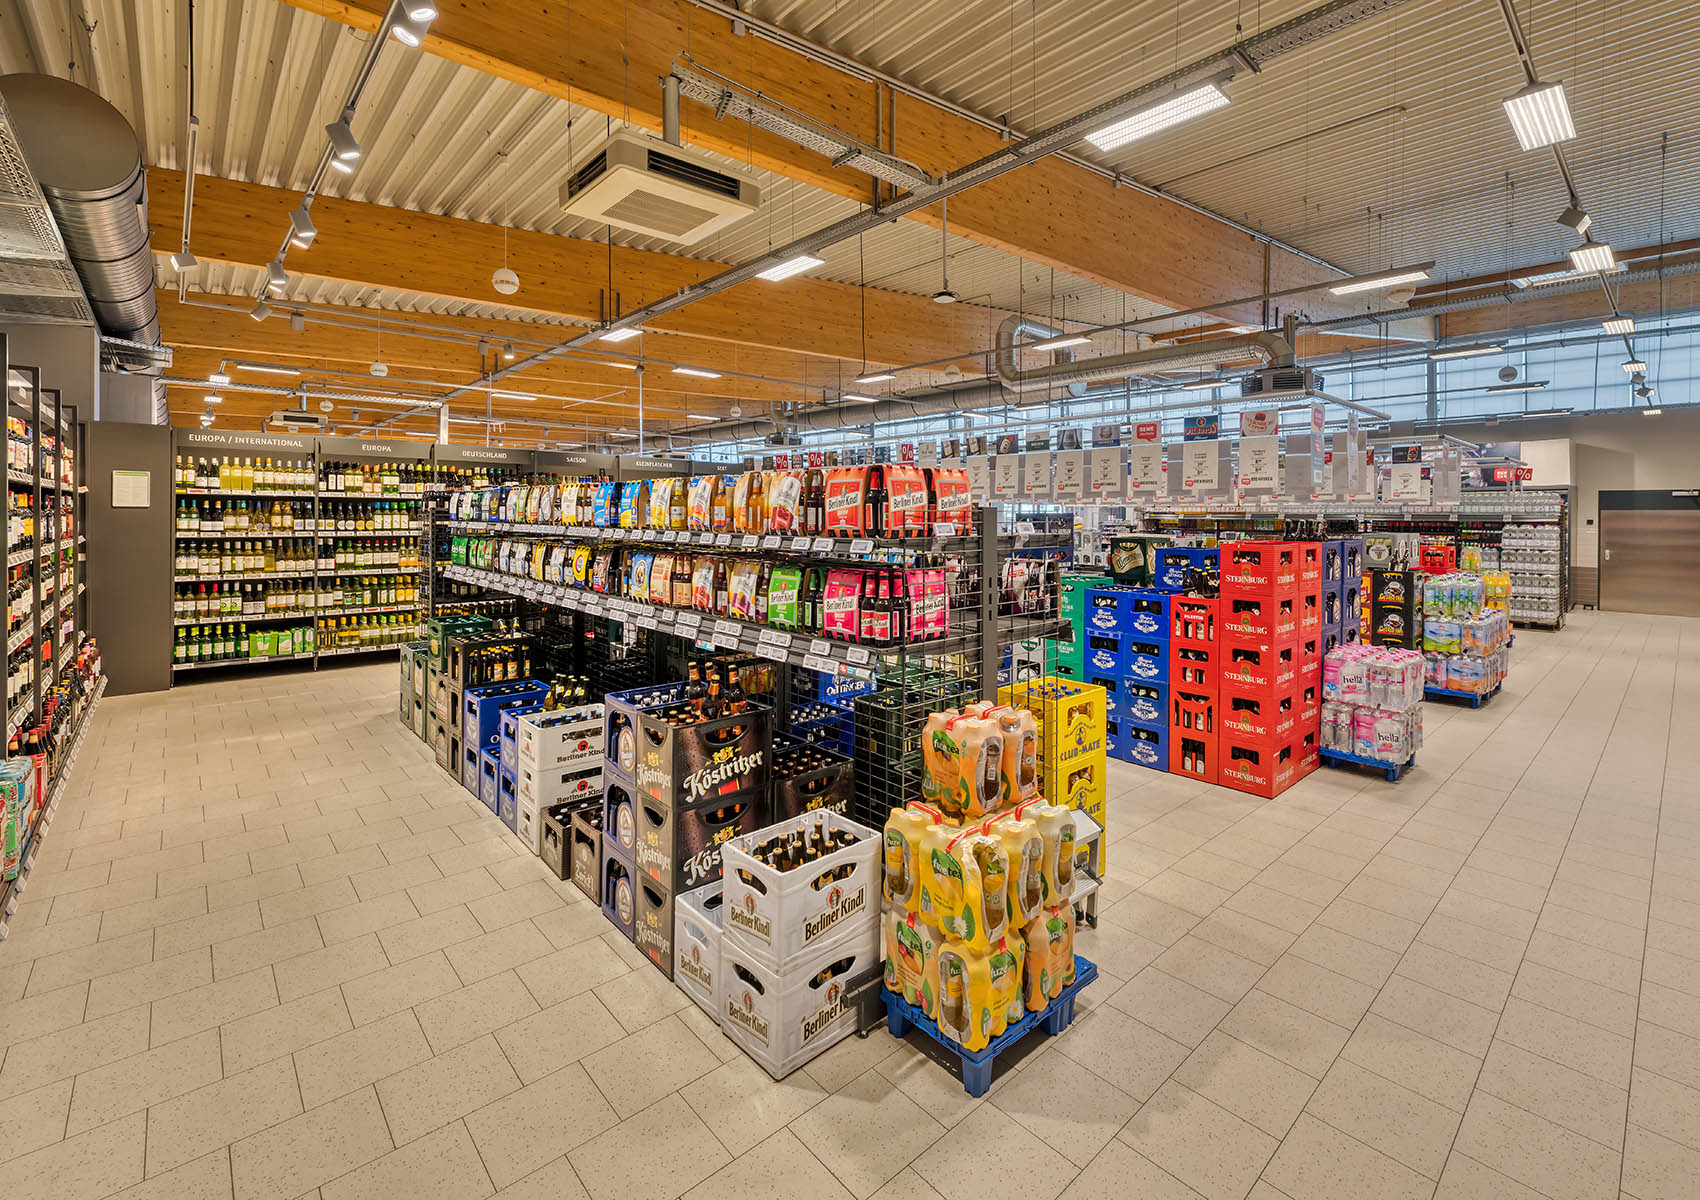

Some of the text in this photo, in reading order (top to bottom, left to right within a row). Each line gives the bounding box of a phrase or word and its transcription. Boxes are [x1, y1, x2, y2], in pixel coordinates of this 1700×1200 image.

[188, 433, 303, 448] EUROPA / INTERNATIONAL
[362, 444, 392, 453] EUROPA
[462, 450, 507, 459] DEUTSCHLAND
[902, 445, 914, 459] %
[566, 456, 587, 464] SAISON
[776, 456, 788, 469] %
[810, 453, 821, 466] %
[1517, 469, 1531, 480] %
[828, 493, 858, 510] Berliner Kindl
[893, 493, 923, 509] Berliner Kindl
[941, 499, 957, 510] Berliner
[1224, 574, 1268, 585] STERNBURG
[770, 592, 783, 603] Berliner
[826, 598, 854, 610] Berliner Kindl
[1224, 622, 1268, 635] STERNBURG
[1224, 671, 1267, 685] STERNBURG
[1343, 675, 1363, 684] hella
[1224, 719, 1266, 735] STERNBURG
[1377, 732, 1399, 743] hella
[557, 747, 606, 763] Berliner Kind
[1060, 739, 1101, 762] CLUB-MATE
[683, 750, 763, 803] Köstritzer
[1223, 767, 1267, 785] STERNBURG
[556, 787, 604, 803] Berliner Kind
[805, 888, 864, 941] Berliner Kindl
[731, 906, 770, 938] Berliner Kindl
[681, 954, 712, 986] Berliner Kindl
[729, 1000, 768, 1039] Berliner Kindl
[804, 1002, 839, 1041] Berliner
